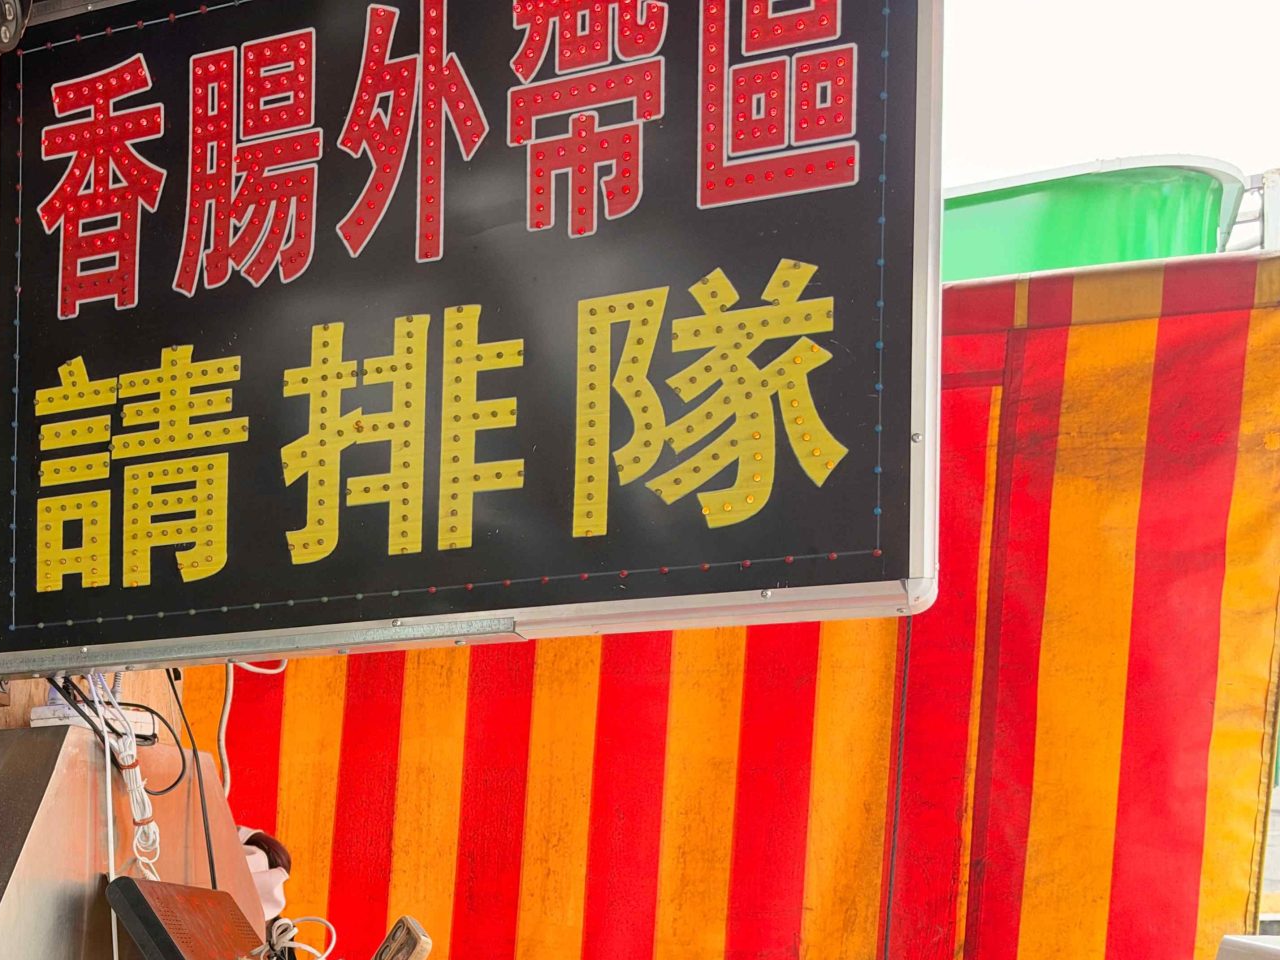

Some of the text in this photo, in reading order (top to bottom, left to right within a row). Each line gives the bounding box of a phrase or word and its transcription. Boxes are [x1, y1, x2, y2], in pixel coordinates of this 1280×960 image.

[36, 0, 859, 320] 香腸外帶區
[34, 258, 850, 593] 請排隊
